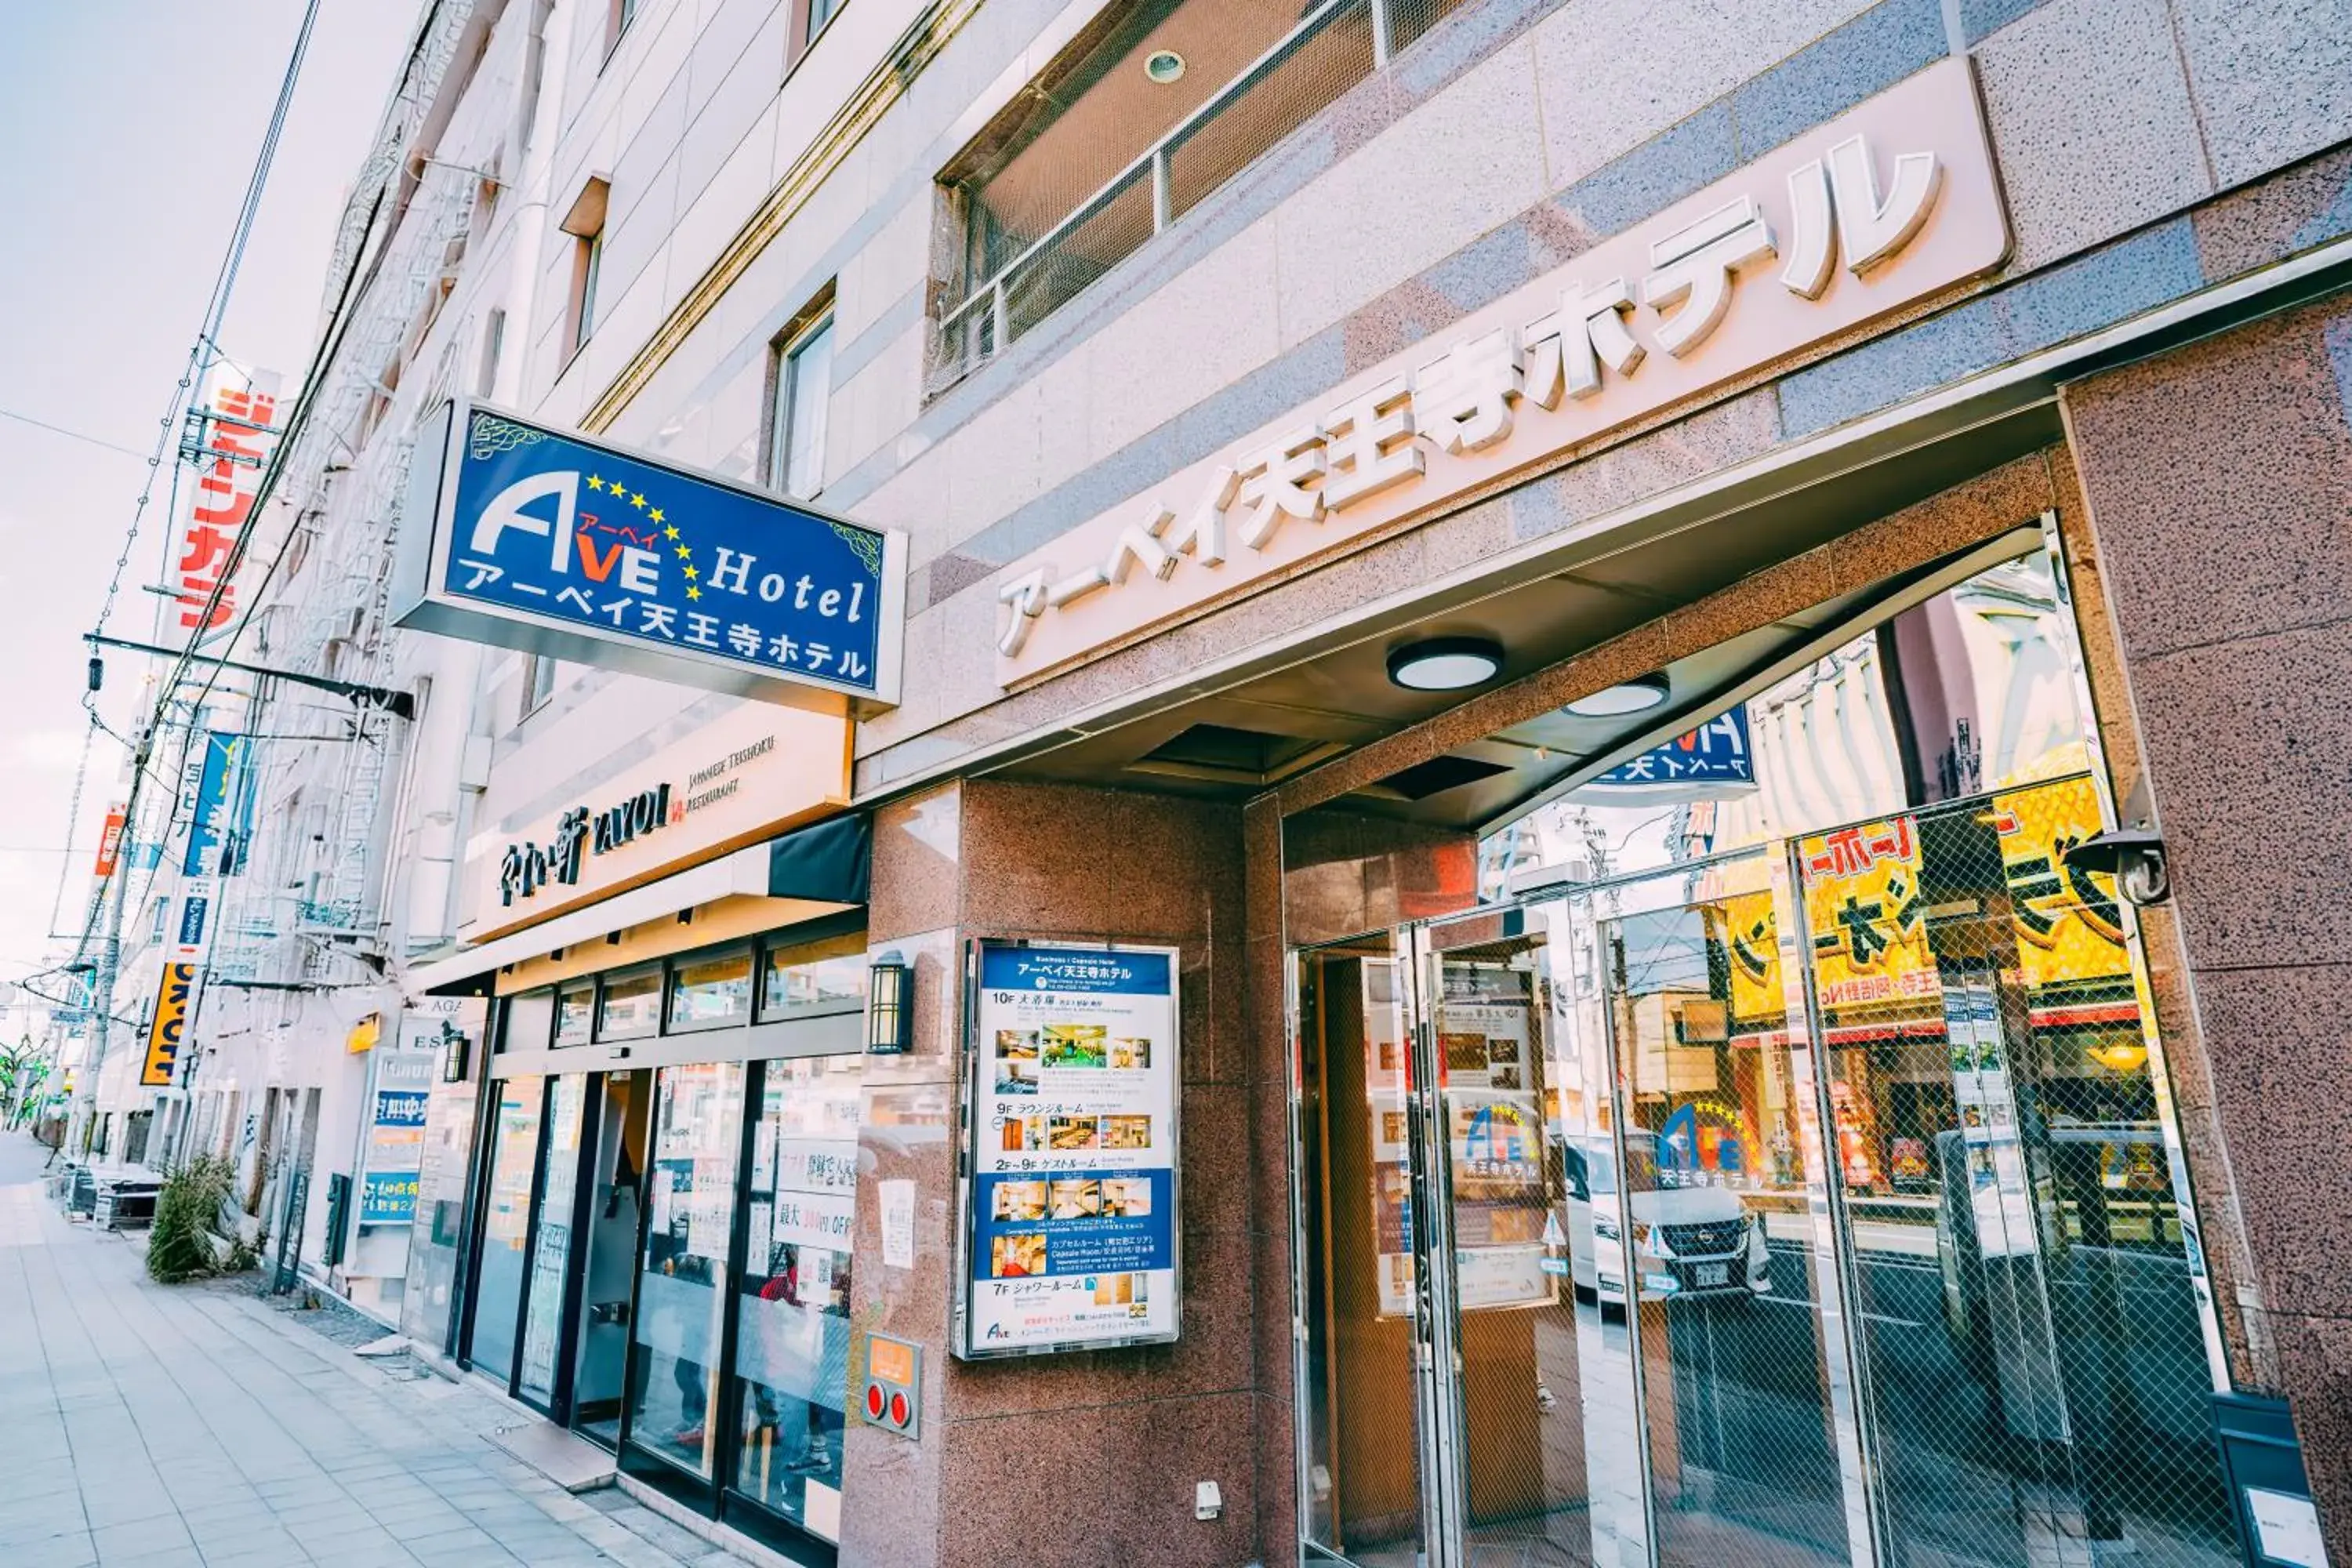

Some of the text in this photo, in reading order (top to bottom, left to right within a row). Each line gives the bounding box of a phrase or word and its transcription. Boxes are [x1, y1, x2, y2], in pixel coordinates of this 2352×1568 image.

[996, 131, 1944, 659] アーベイ天王寺ホテル
[577, 512, 658, 550] アーベイ
[470, 470, 865, 623] AVE Hotel
[457, 558, 866, 679] アーベイ天王寺ホテル
[728, 735, 775, 769] TEISHOKU
[686, 777, 740, 815] RESTAURANT
[593, 783, 671, 855] YAYOI
[1018, 964, 1131, 980] アーベイ天王寺ホテル
[993, 993, 1015, 1004] 10F
[996, 1103, 1013, 1114] 9F
[1018, 1103, 1083, 1114] ラウンジルーム
[1042, 1159, 1097, 1170] ゲストルーム
[1467, 1160, 1537, 1177] 天王寺ホテル
[1661, 1169, 1763, 1189] 天王寺ホテル
[993, 1280, 1082, 1296] 7F シャワールーム
